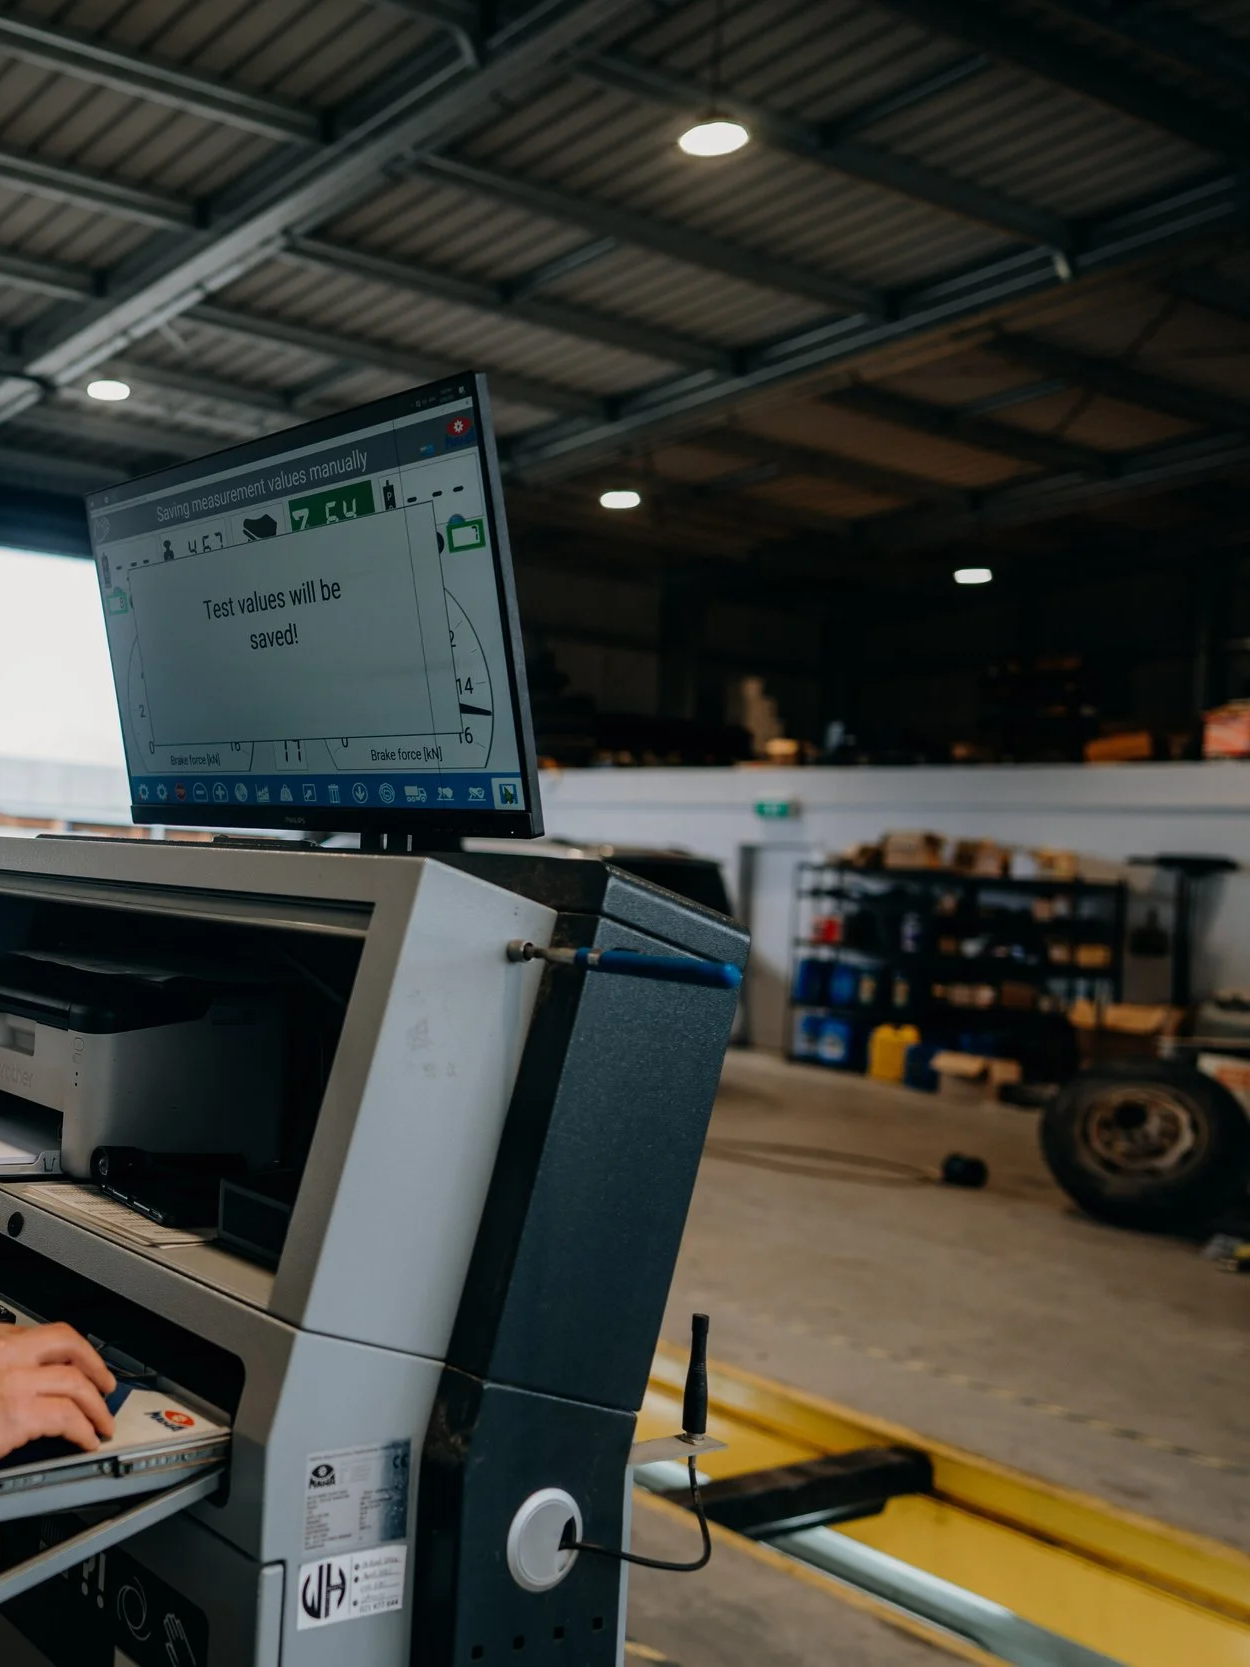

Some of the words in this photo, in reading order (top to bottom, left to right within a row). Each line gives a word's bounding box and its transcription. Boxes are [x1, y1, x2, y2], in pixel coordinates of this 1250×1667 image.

[156, 501, 190, 522] Saving
[191, 478, 265, 511] measurement
[267, 470, 307, 492] values
[309, 449, 368, 481] manually
[203, 597, 235, 620] Test
[237, 590, 286, 614] values
[289, 580, 317, 606] will
[319, 578, 342, 601] be
[249, 622, 299, 650] saved!
[455, 677, 474, 695] 14
[138, 704, 147, 719] 2
[170, 753, 189, 766] Brake
[189, 753, 206, 766] force
[370, 748, 396, 762] Brake
[397, 747, 422, 760] force
[424, 746, 443, 762] [kN]
